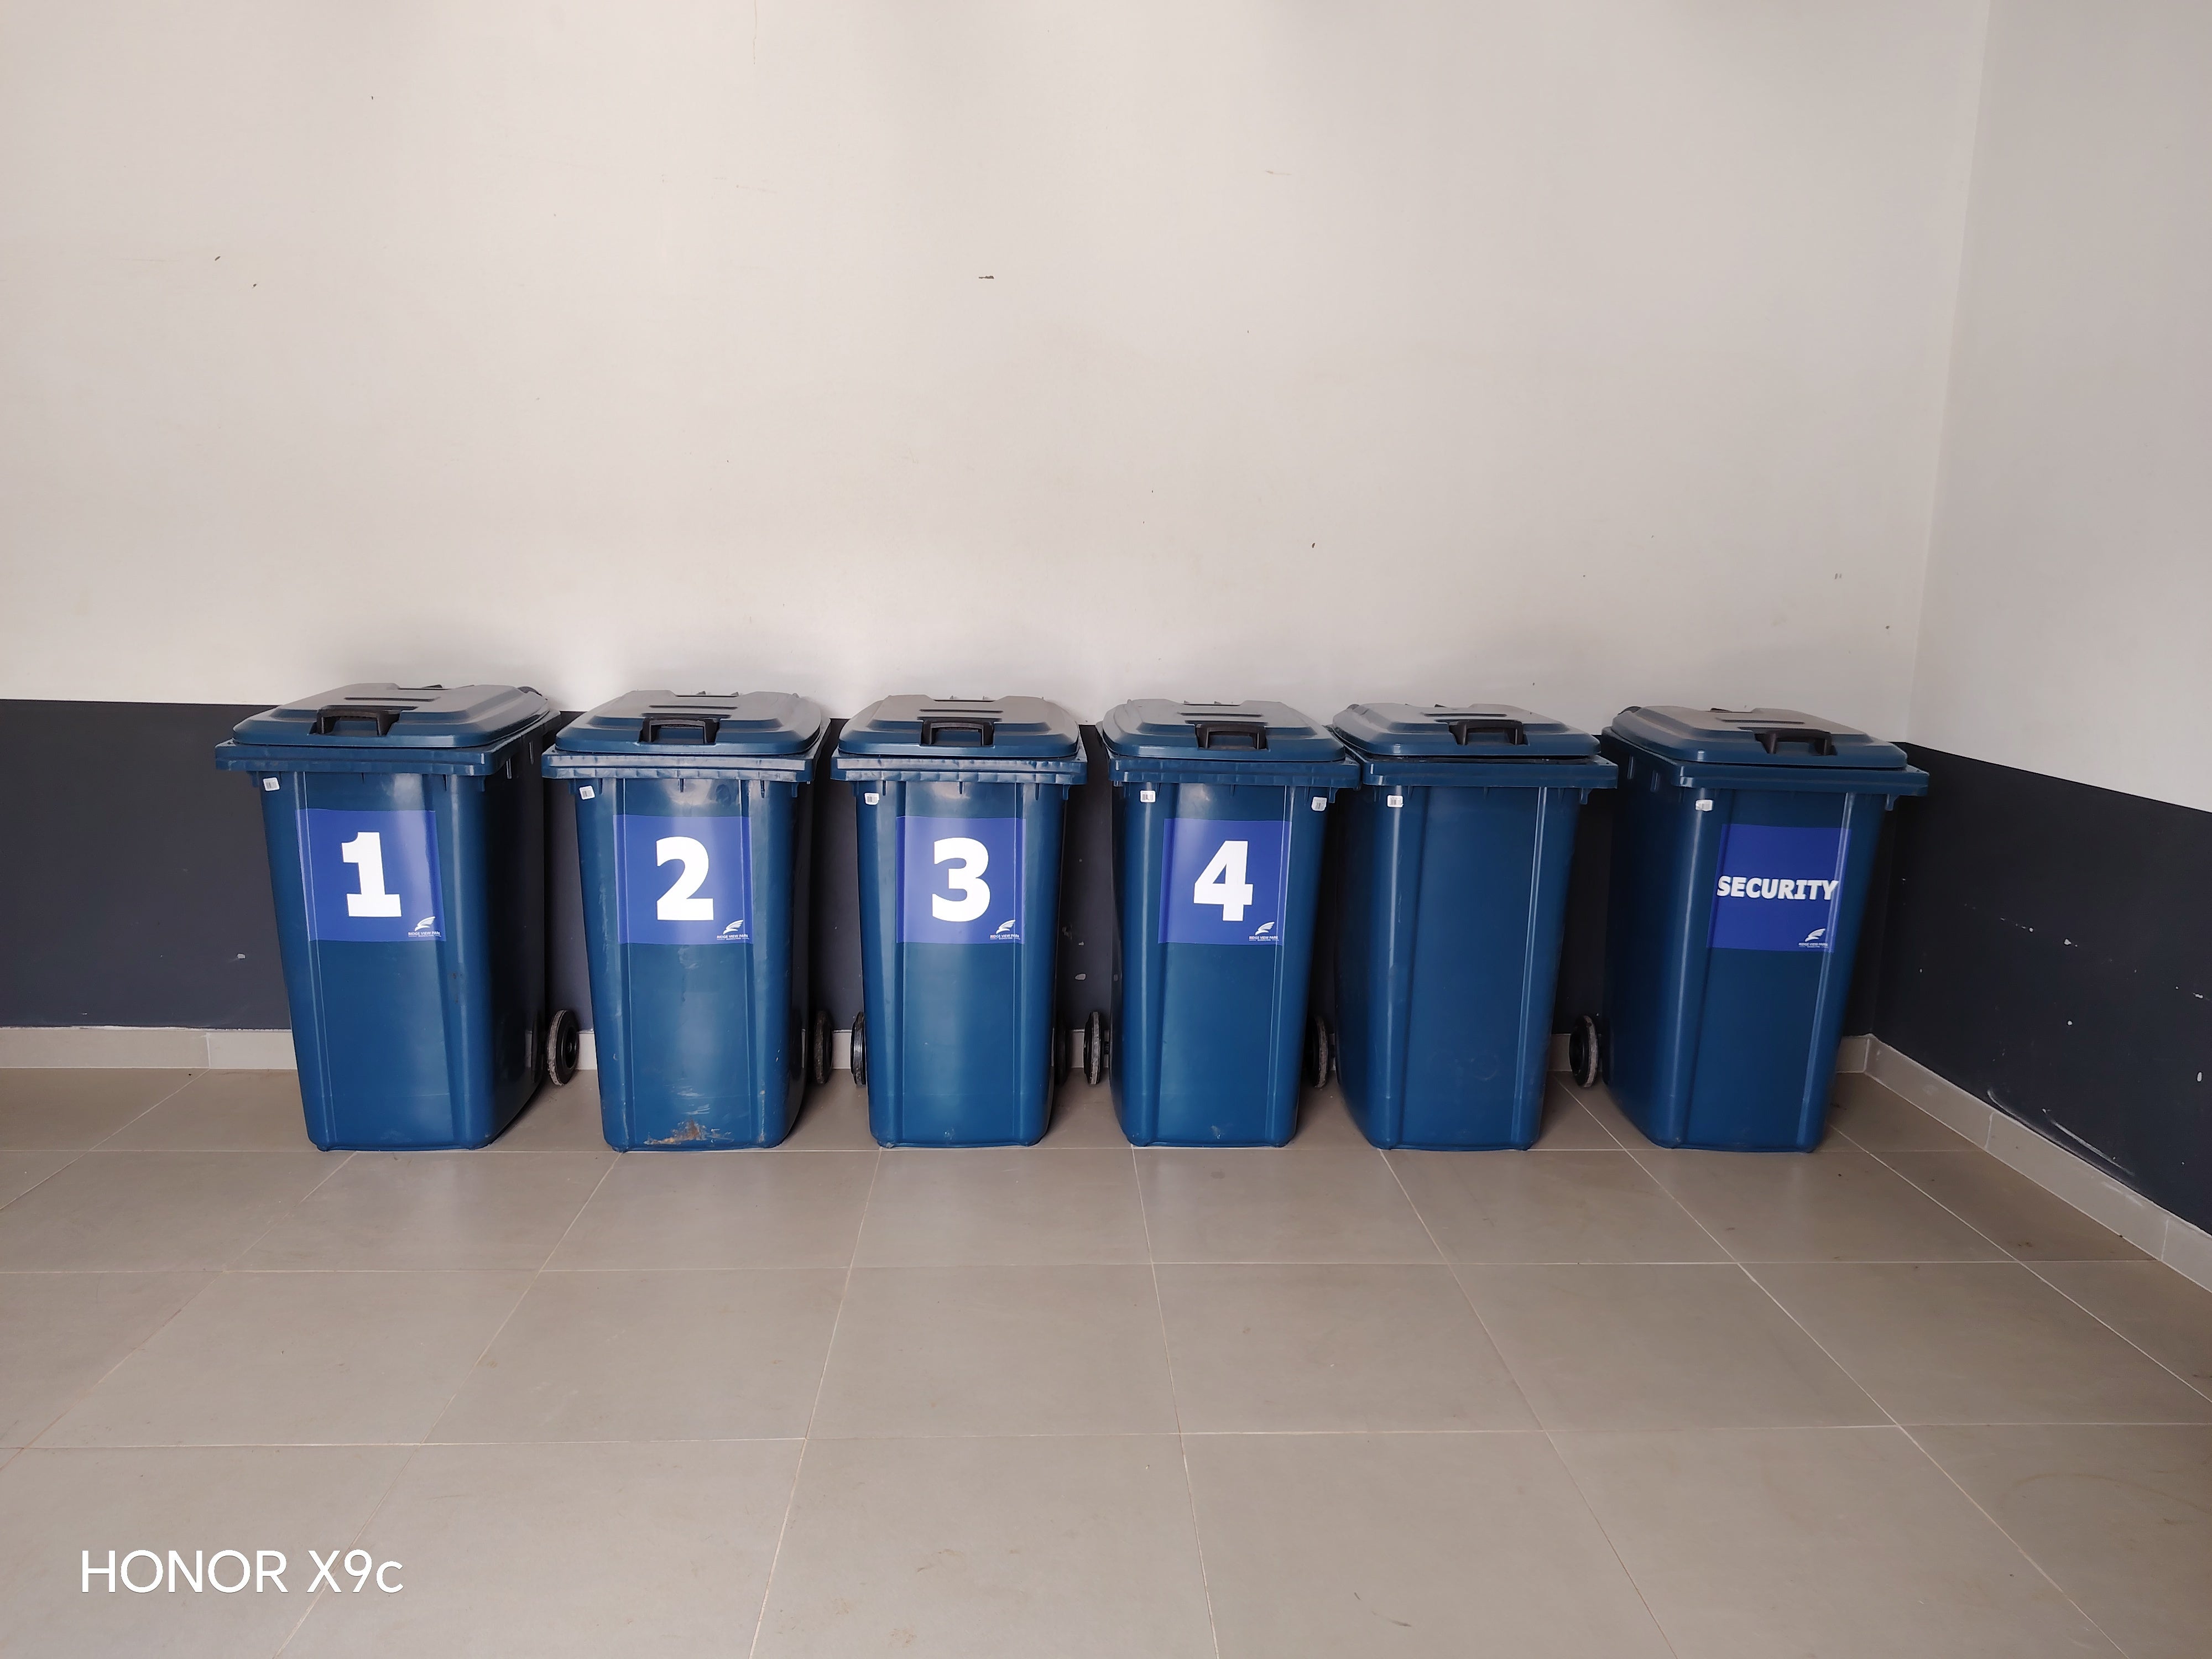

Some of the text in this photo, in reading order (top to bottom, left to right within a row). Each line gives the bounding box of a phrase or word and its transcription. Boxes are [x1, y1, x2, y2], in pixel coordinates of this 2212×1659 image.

[342, 832, 402, 917] 1
[656, 836, 714, 921] 2
[932, 837, 990, 922] 3
[1193, 840, 1253, 921] 4
[1717, 875, 1839, 900] SECURITY
